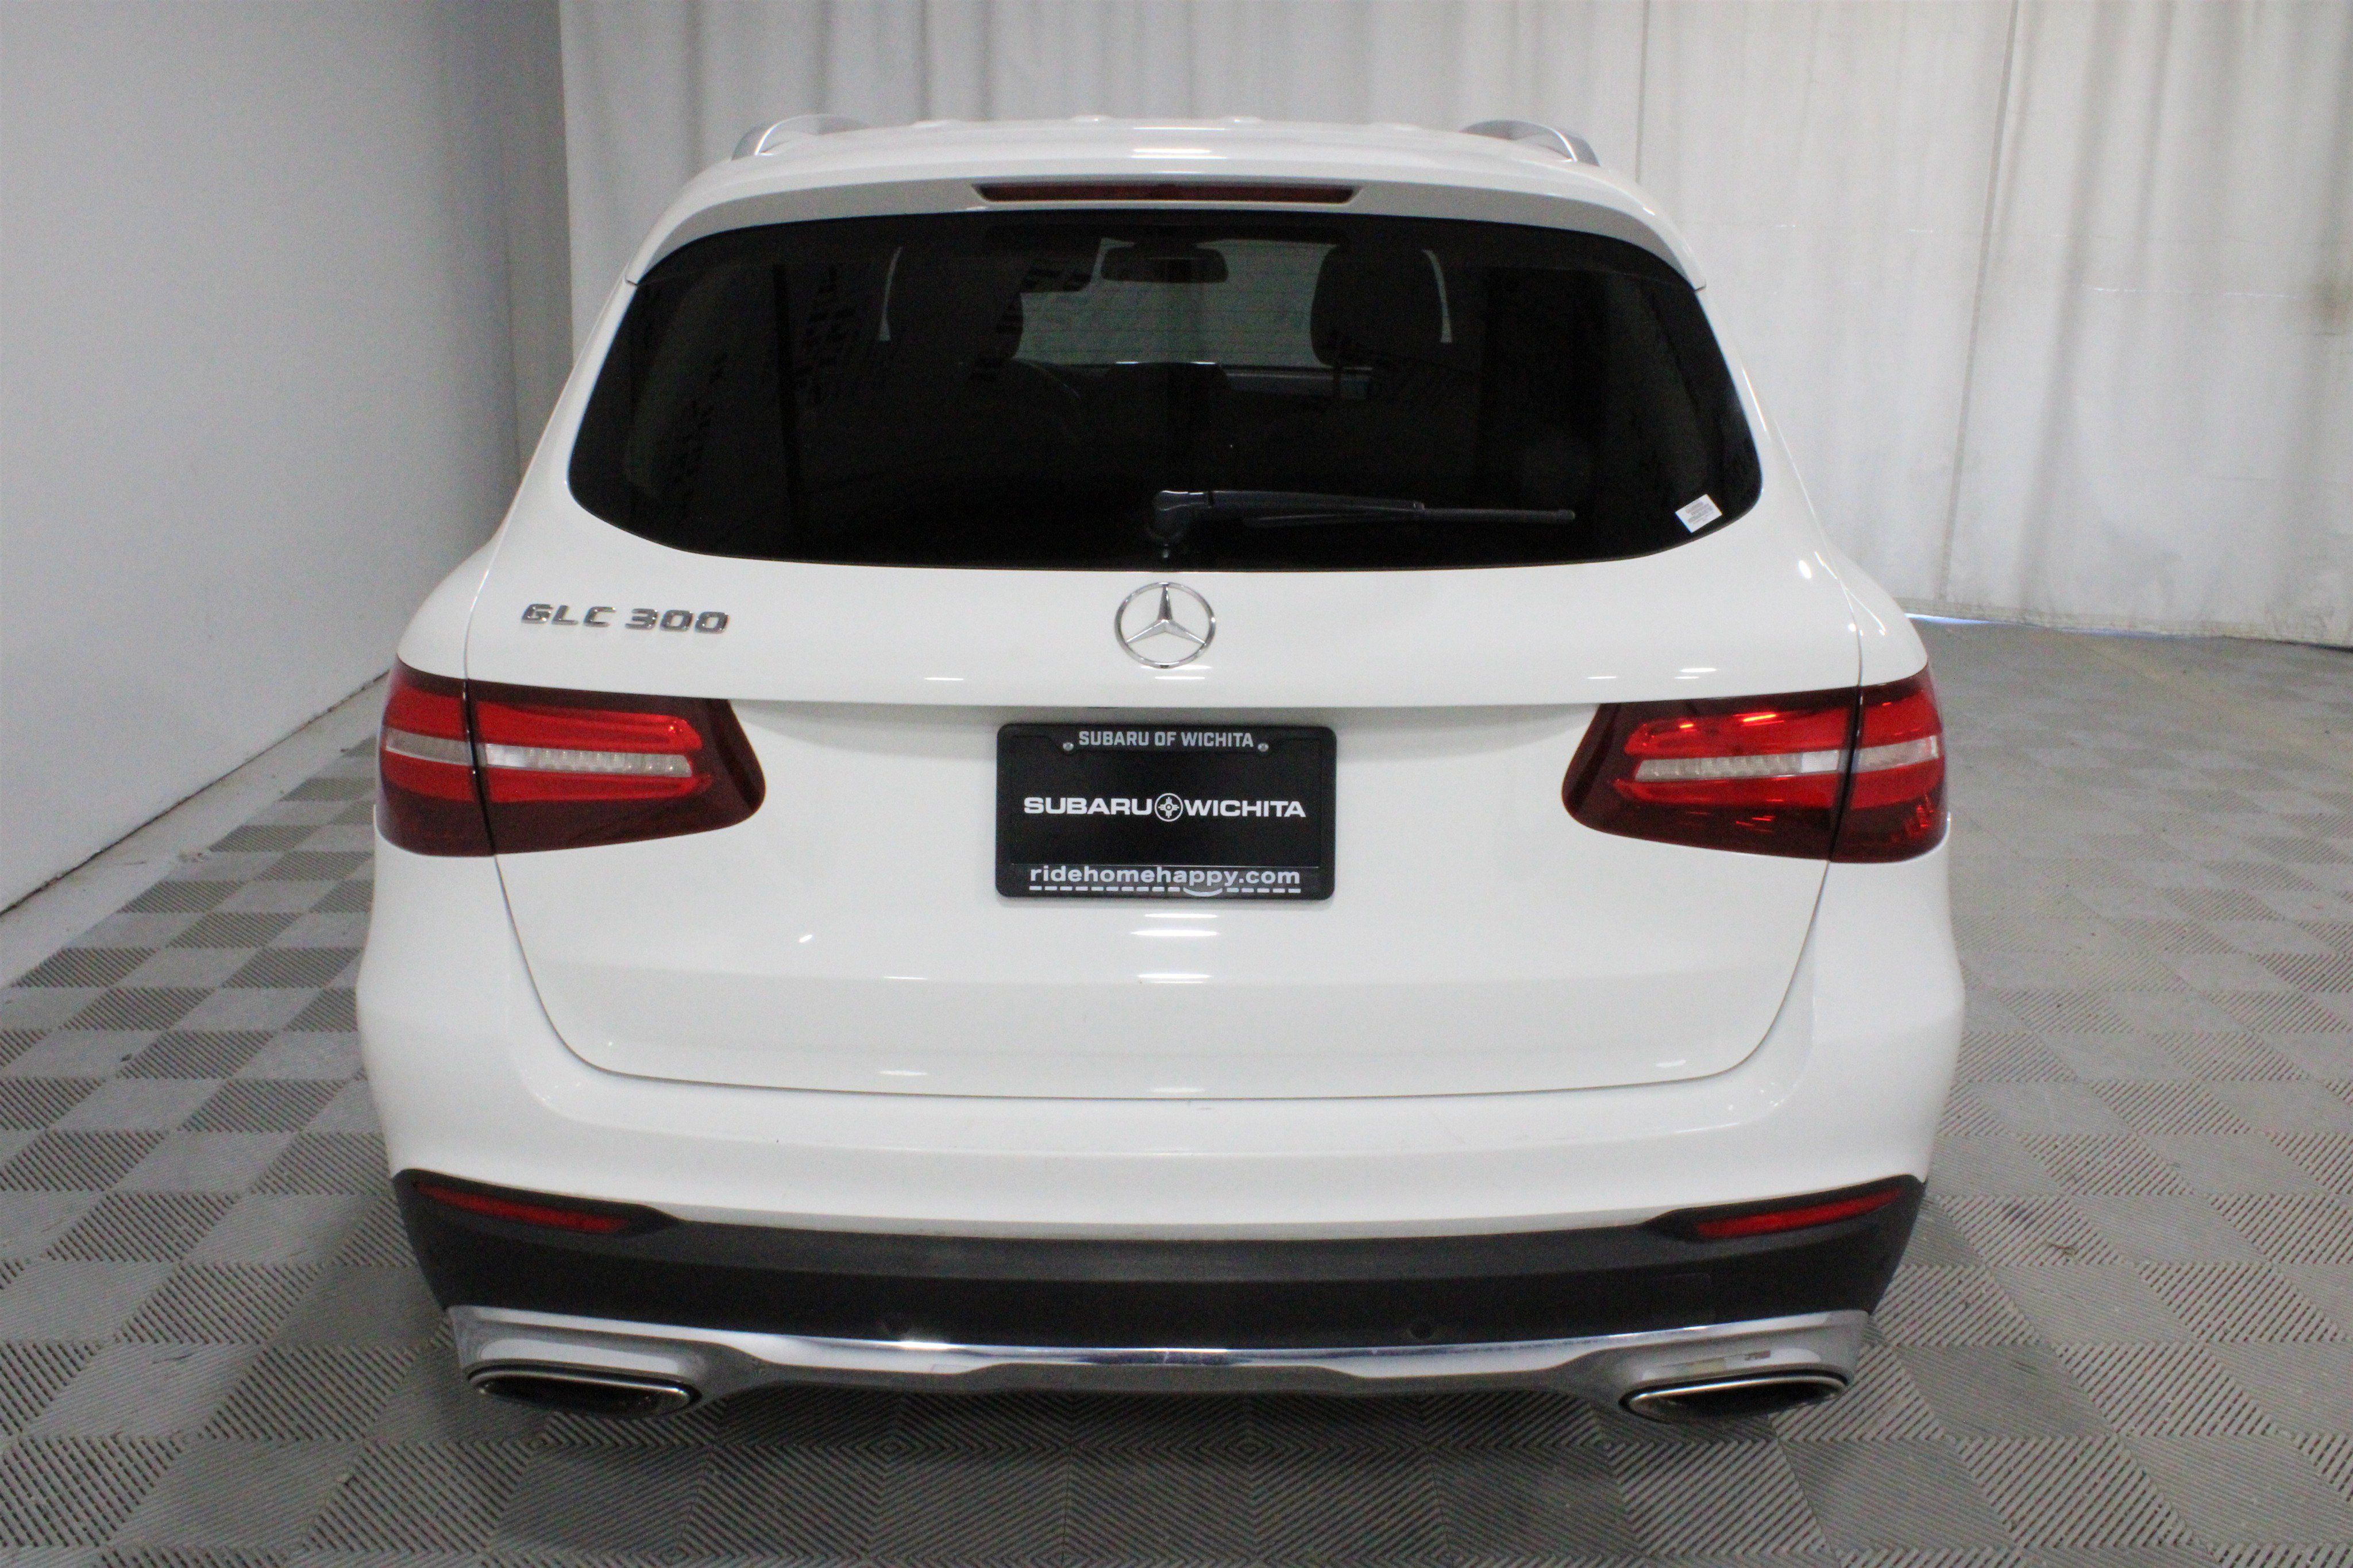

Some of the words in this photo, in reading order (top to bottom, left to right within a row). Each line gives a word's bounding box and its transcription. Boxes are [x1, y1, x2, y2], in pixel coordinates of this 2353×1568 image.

[521, 603, 616, 628] GLC
[624, 608, 731, 634] 300
[1078, 731, 1150, 747] SUBARU
[1154, 731, 1176, 747] OF
[1181, 732, 1254, 748] WICHITA
[1024, 797, 1153, 816] SUBARU
[1184, 800, 1307, 818] WICHITA
[1029, 866, 1300, 887] ridehomehappy.com
